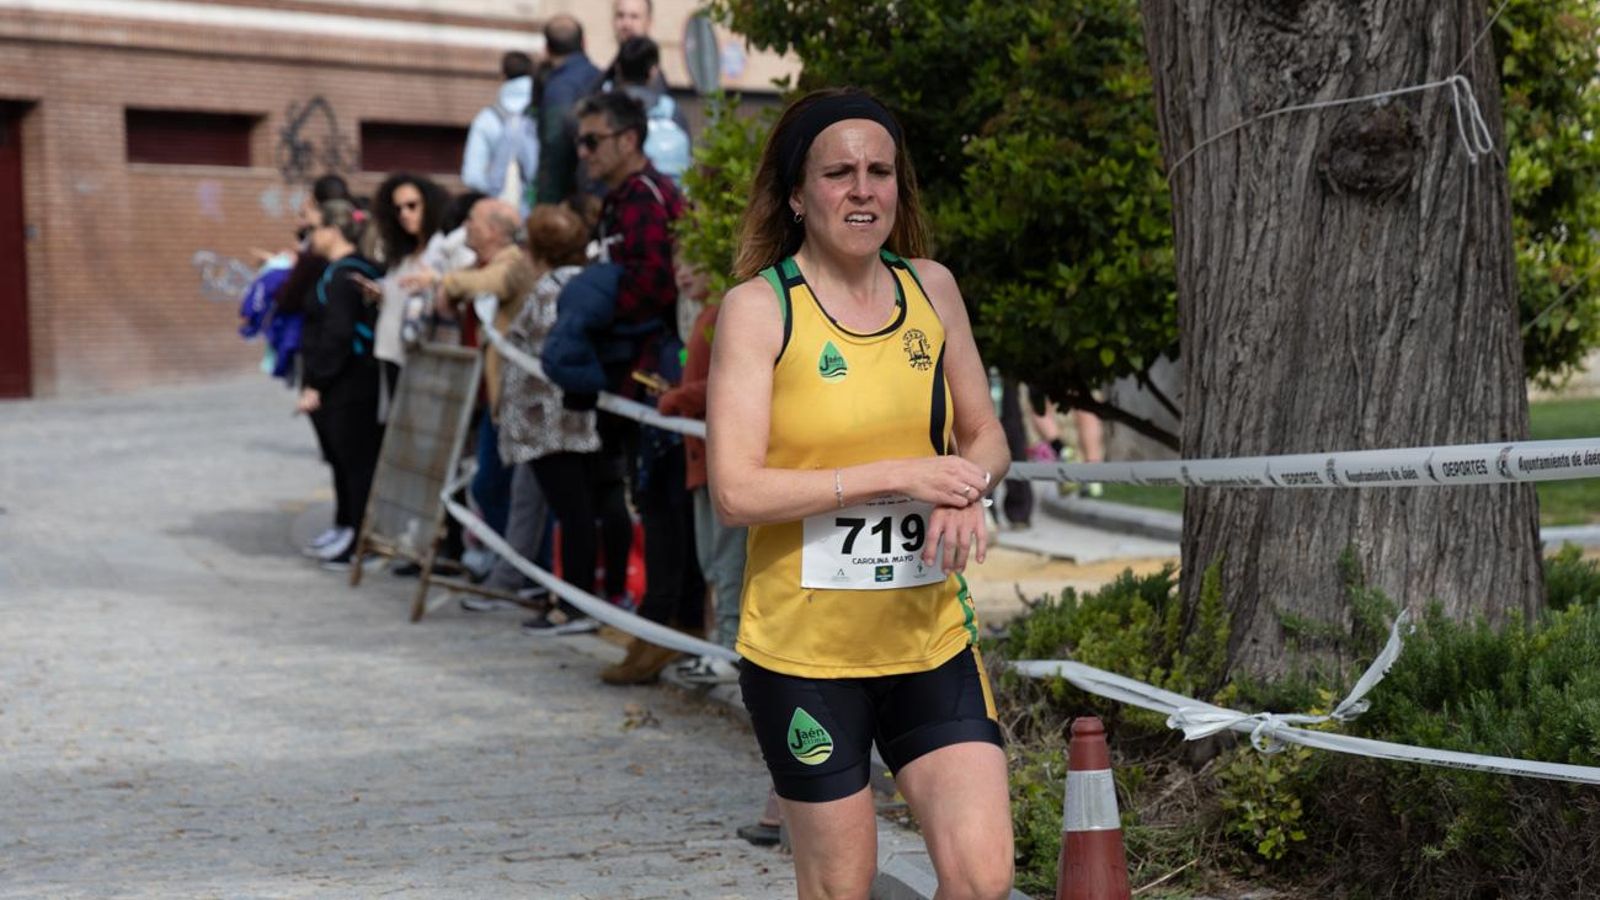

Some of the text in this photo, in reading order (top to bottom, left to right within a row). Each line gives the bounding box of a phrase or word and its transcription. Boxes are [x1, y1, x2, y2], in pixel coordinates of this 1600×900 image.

[1442, 459, 1488, 477] DEPORTES
[1519, 453, 1570, 474] Ayuntamiento
[1571, 451, 1582, 467] de
[835, 513, 925, 554] 719
[852, 554, 914, 565] CAROLINA MAYO
[791, 728, 824, 749] Jaén
